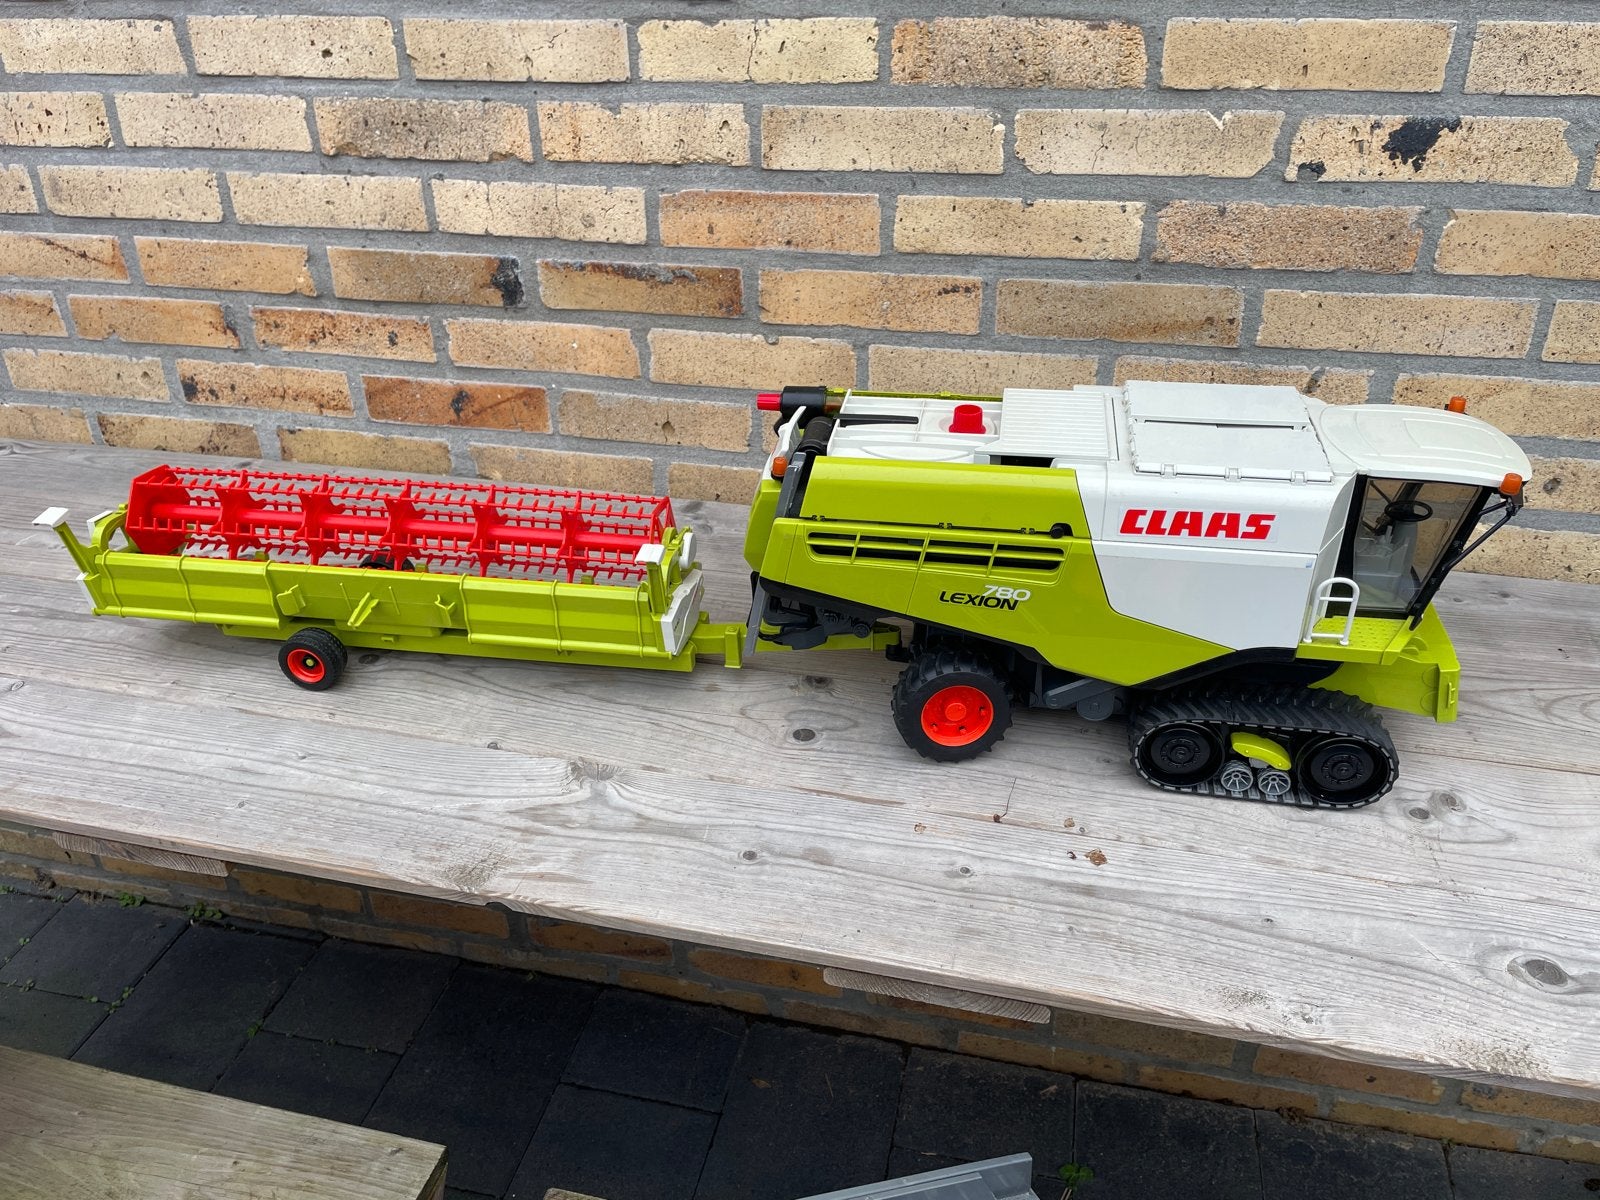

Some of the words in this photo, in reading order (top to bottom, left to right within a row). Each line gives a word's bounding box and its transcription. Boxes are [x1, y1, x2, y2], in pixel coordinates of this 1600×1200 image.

[1120, 509, 1276, 540] CLAAS
[940, 591, 1018, 610] LEXION
[983, 585, 1031, 601] 780
